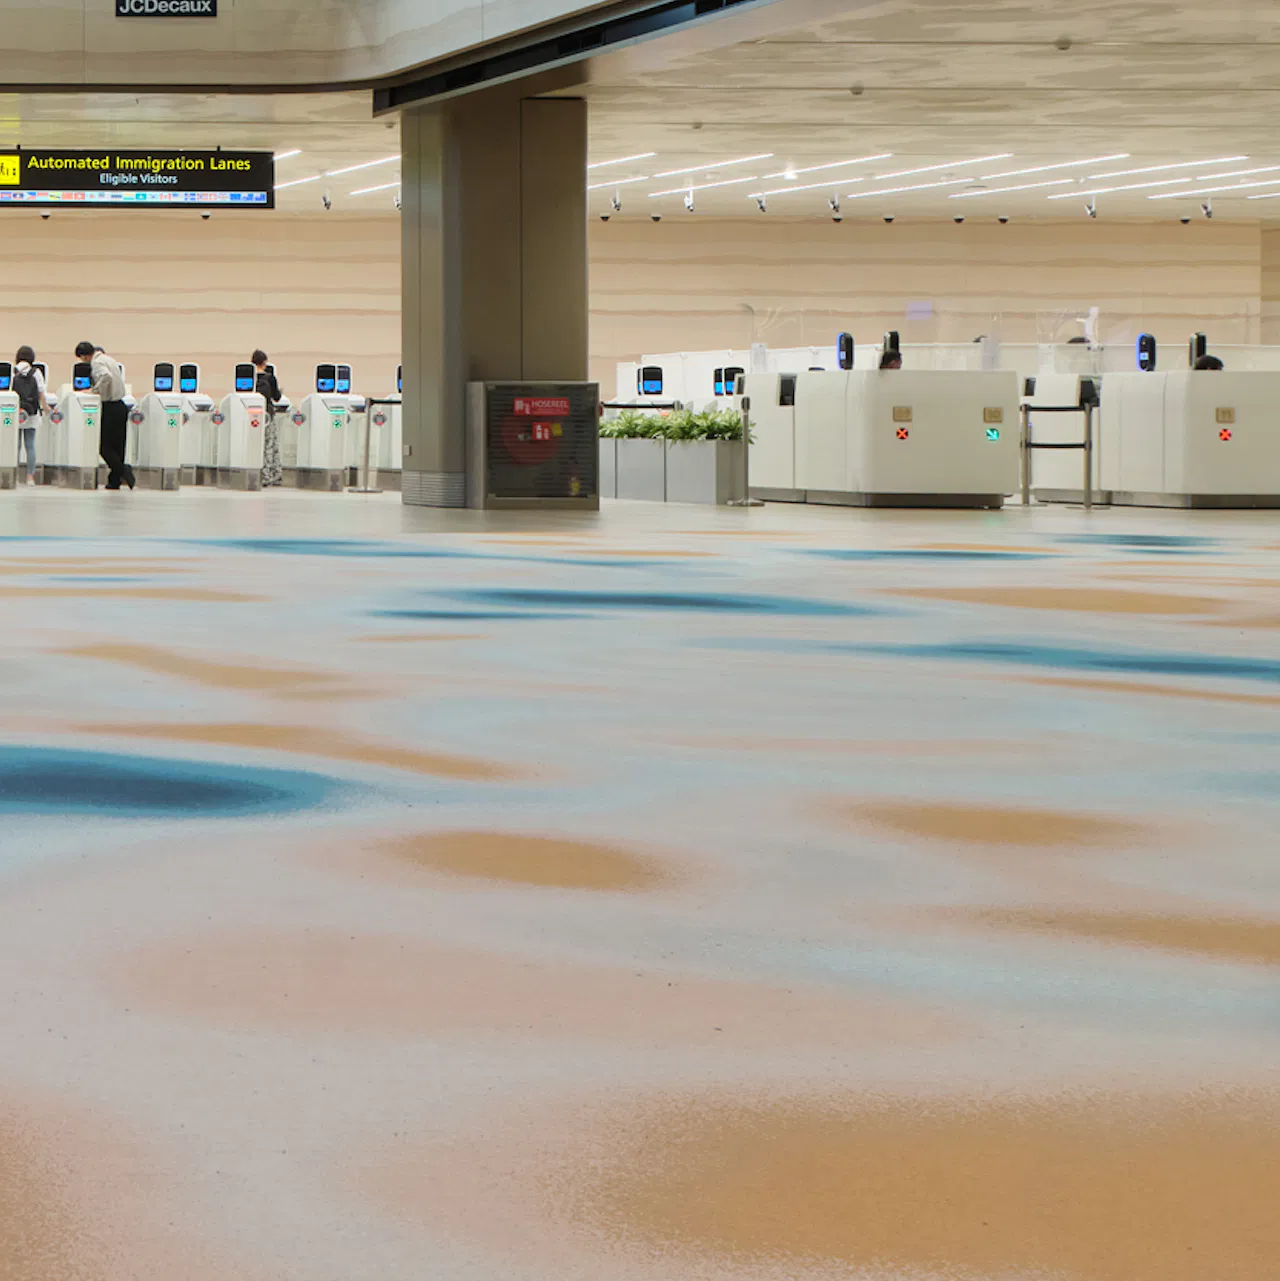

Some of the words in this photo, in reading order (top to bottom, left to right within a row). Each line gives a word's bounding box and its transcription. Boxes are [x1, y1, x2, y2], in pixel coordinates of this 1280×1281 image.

[28, 156, 110, 170] Automated
[116, 156, 204, 172] Immigration
[210, 157, 252, 171] Lanes
[99, 173, 138, 186] Eligible
[140, 173, 178, 184] Visitors
